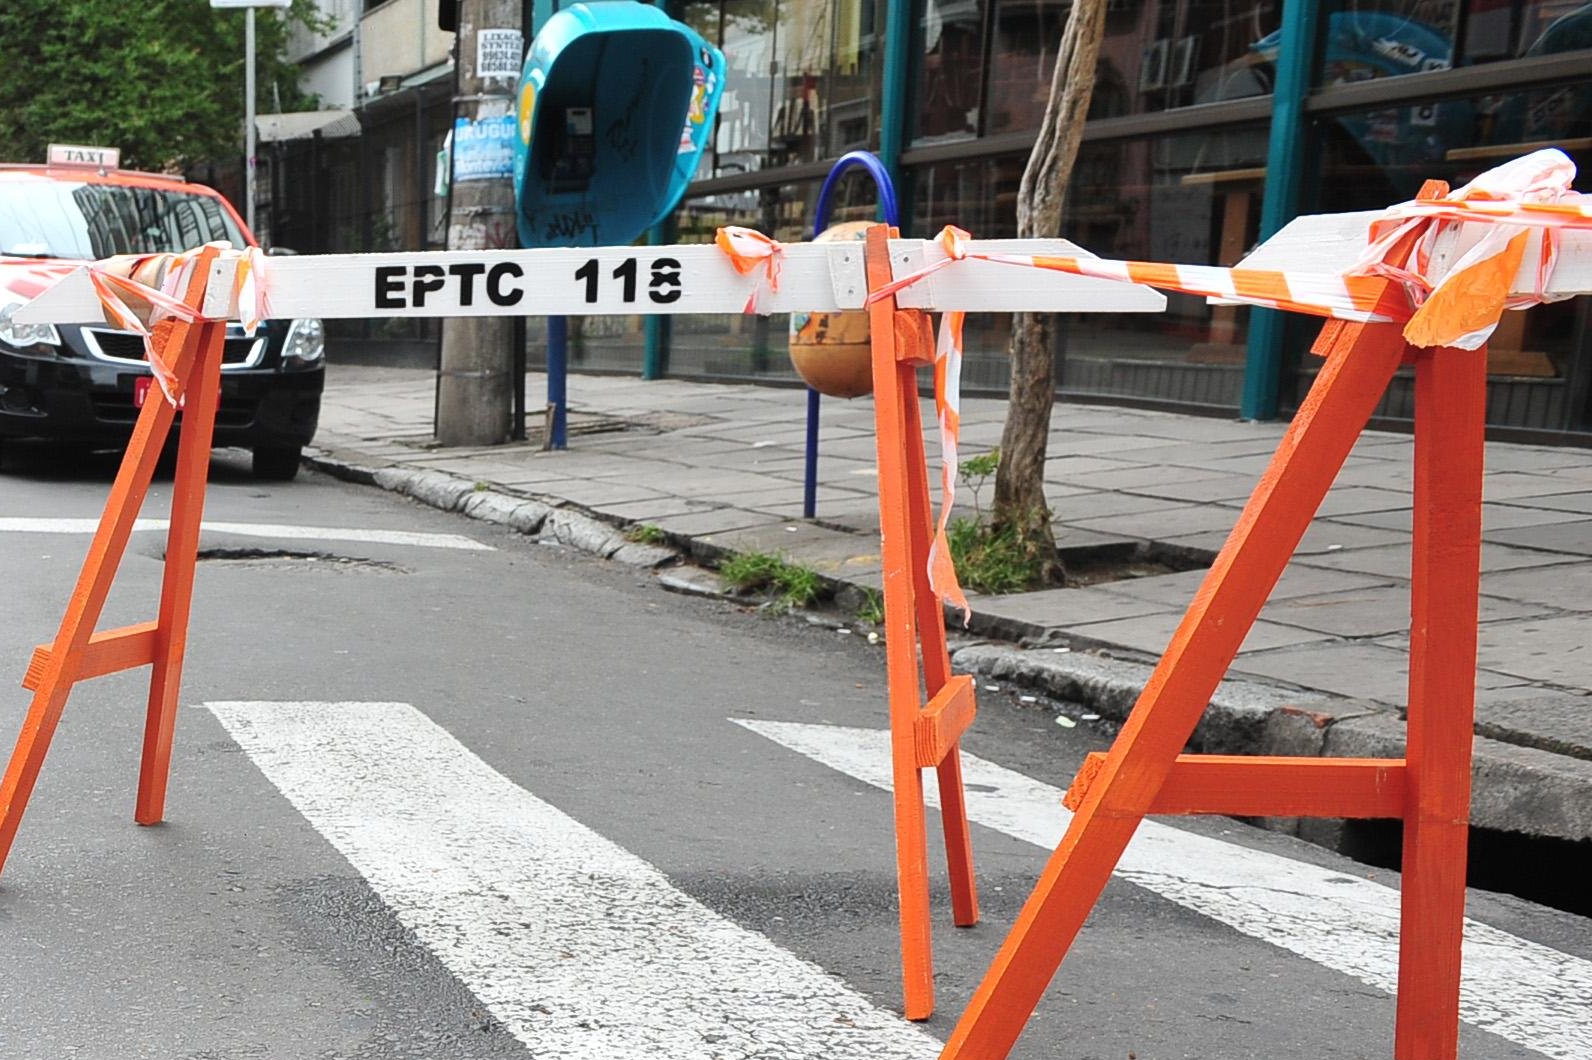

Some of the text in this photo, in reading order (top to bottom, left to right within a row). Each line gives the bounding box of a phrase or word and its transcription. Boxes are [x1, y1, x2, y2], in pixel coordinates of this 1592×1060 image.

[64, 150, 104, 164] TAXI
[375, 257, 682, 308] EPTC 118
